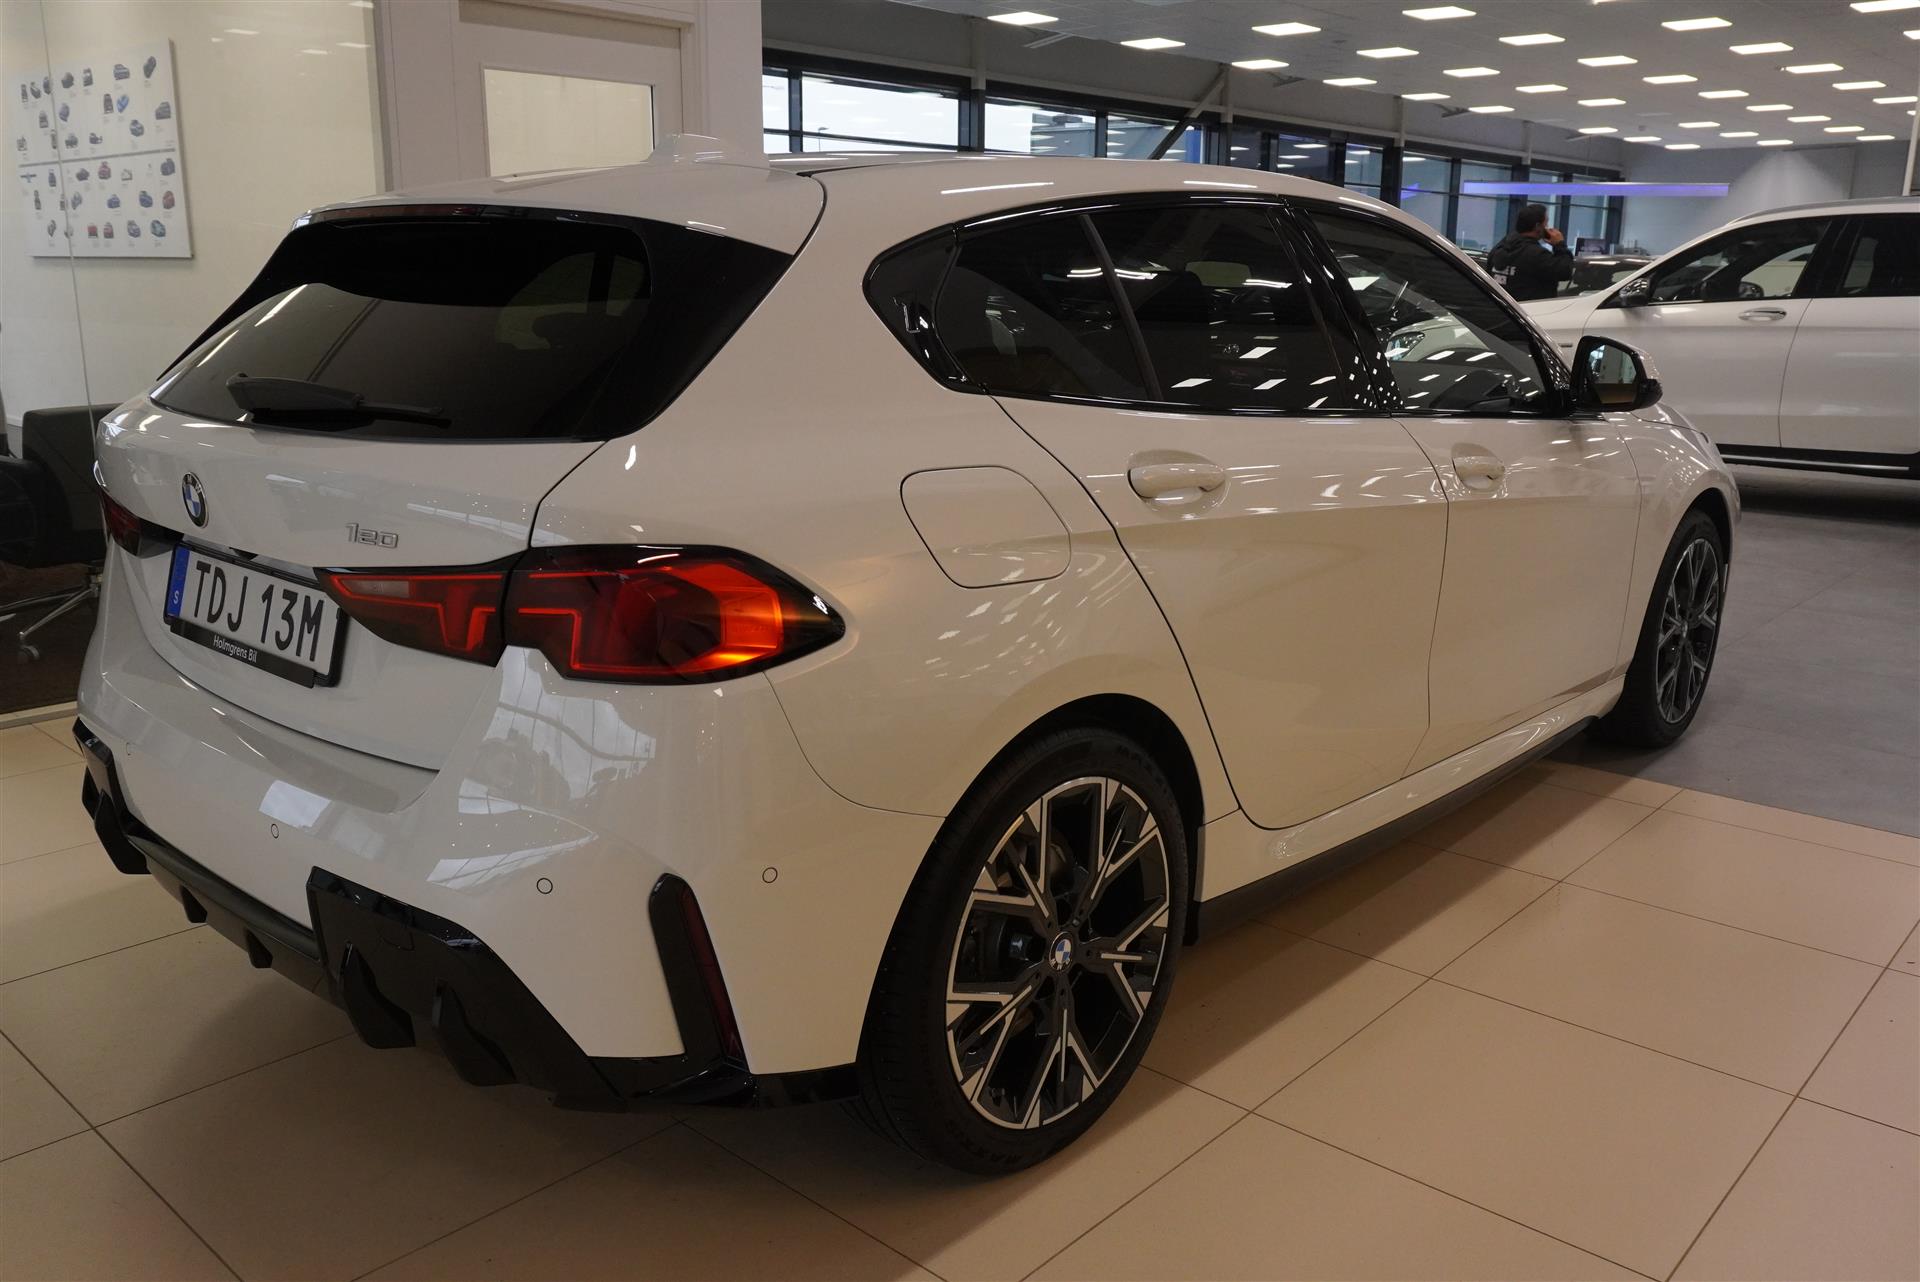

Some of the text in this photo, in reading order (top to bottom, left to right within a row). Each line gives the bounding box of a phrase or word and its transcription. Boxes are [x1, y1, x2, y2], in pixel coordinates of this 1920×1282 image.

[345, 523, 399, 549] 120
[173, 590, 180, 604] S
[193, 560, 324, 662] TDJ 13M
[213, 634, 257, 663] Holmgrens Bil
